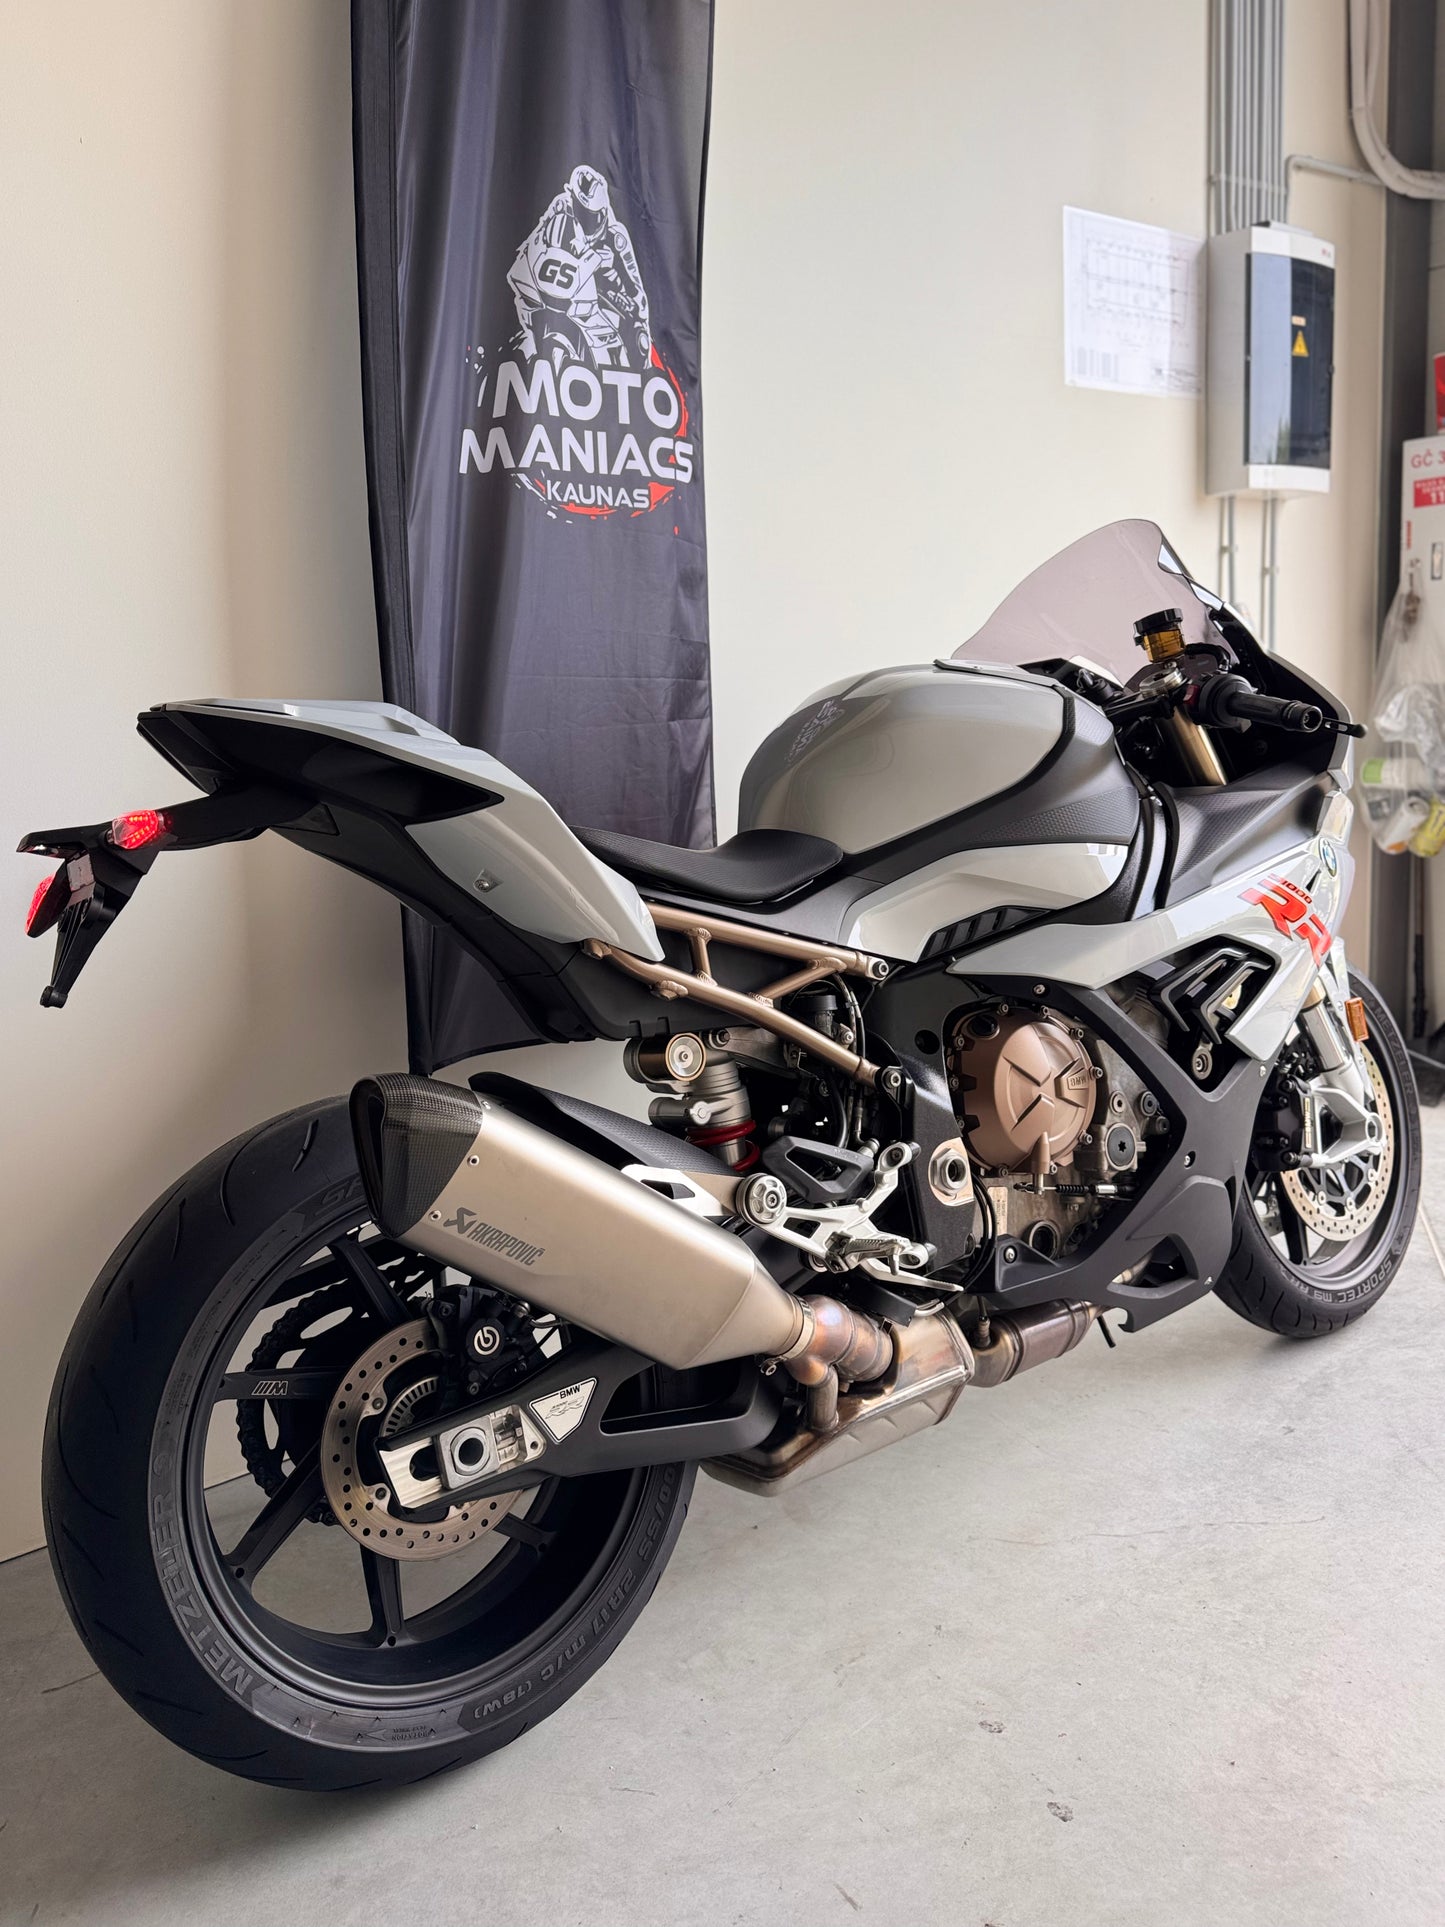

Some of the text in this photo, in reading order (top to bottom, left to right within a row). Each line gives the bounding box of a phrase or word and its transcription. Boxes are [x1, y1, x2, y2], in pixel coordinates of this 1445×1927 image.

[537, 259, 577, 290] GS
[492, 360, 679, 429] MOTO
[459, 424, 694, 484] MANIACS
[547, 480, 650, 508] KAUNAS
[1281, 880, 1313, 904] 1000
[1374, 1006, 1413, 1095] METZELER
[1337, 1254, 1392, 1303] SPORTEC
[559, 1384, 581, 1399] BMW
[152, 1493, 254, 1696] METZELER
